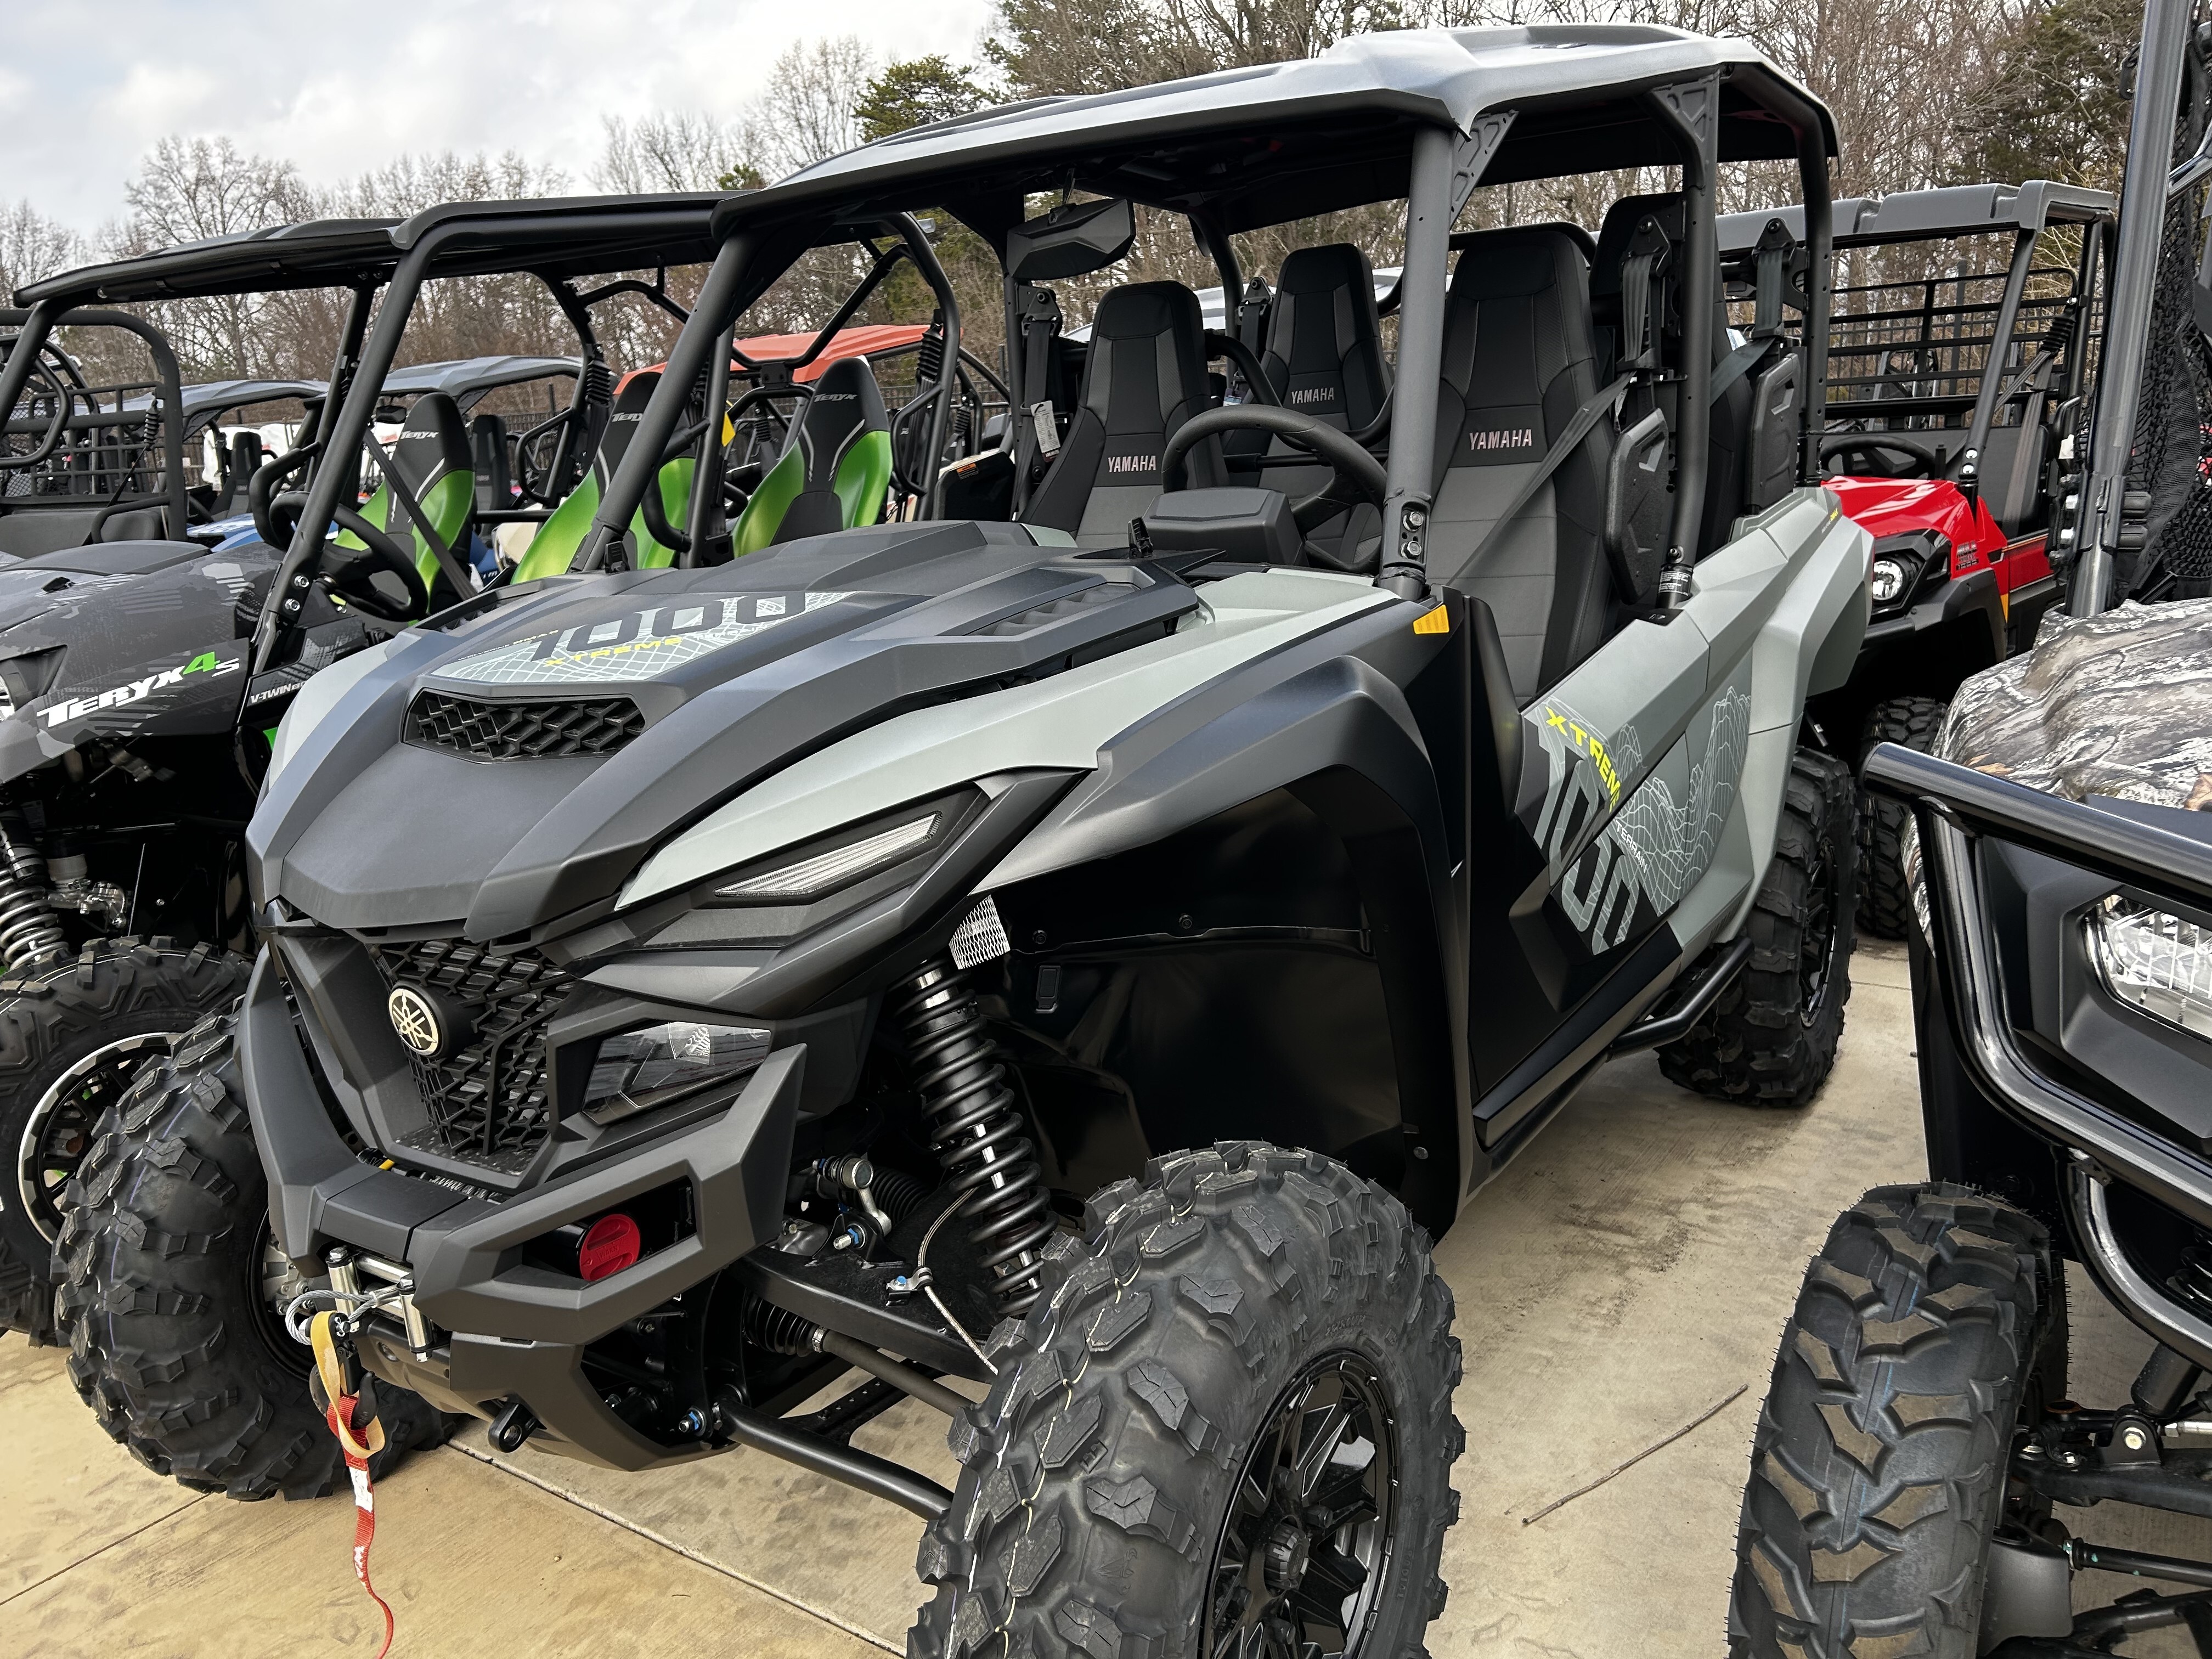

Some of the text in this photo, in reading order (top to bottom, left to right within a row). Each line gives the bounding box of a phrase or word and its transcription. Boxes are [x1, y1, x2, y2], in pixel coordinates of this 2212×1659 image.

[1291, 387, 1334, 404] YAMAHA
[1469, 429, 1532, 450] YAMAHA
[1108, 455, 1156, 472] YAMAHA
[531, 592, 805, 662] 1000
[542, 636, 684, 668] XTREME
[251, 683, 291, 703] V-TWIN
[1544, 706, 1621, 814] XTREME
[1616, 820, 1647, 874] TERRAIN
